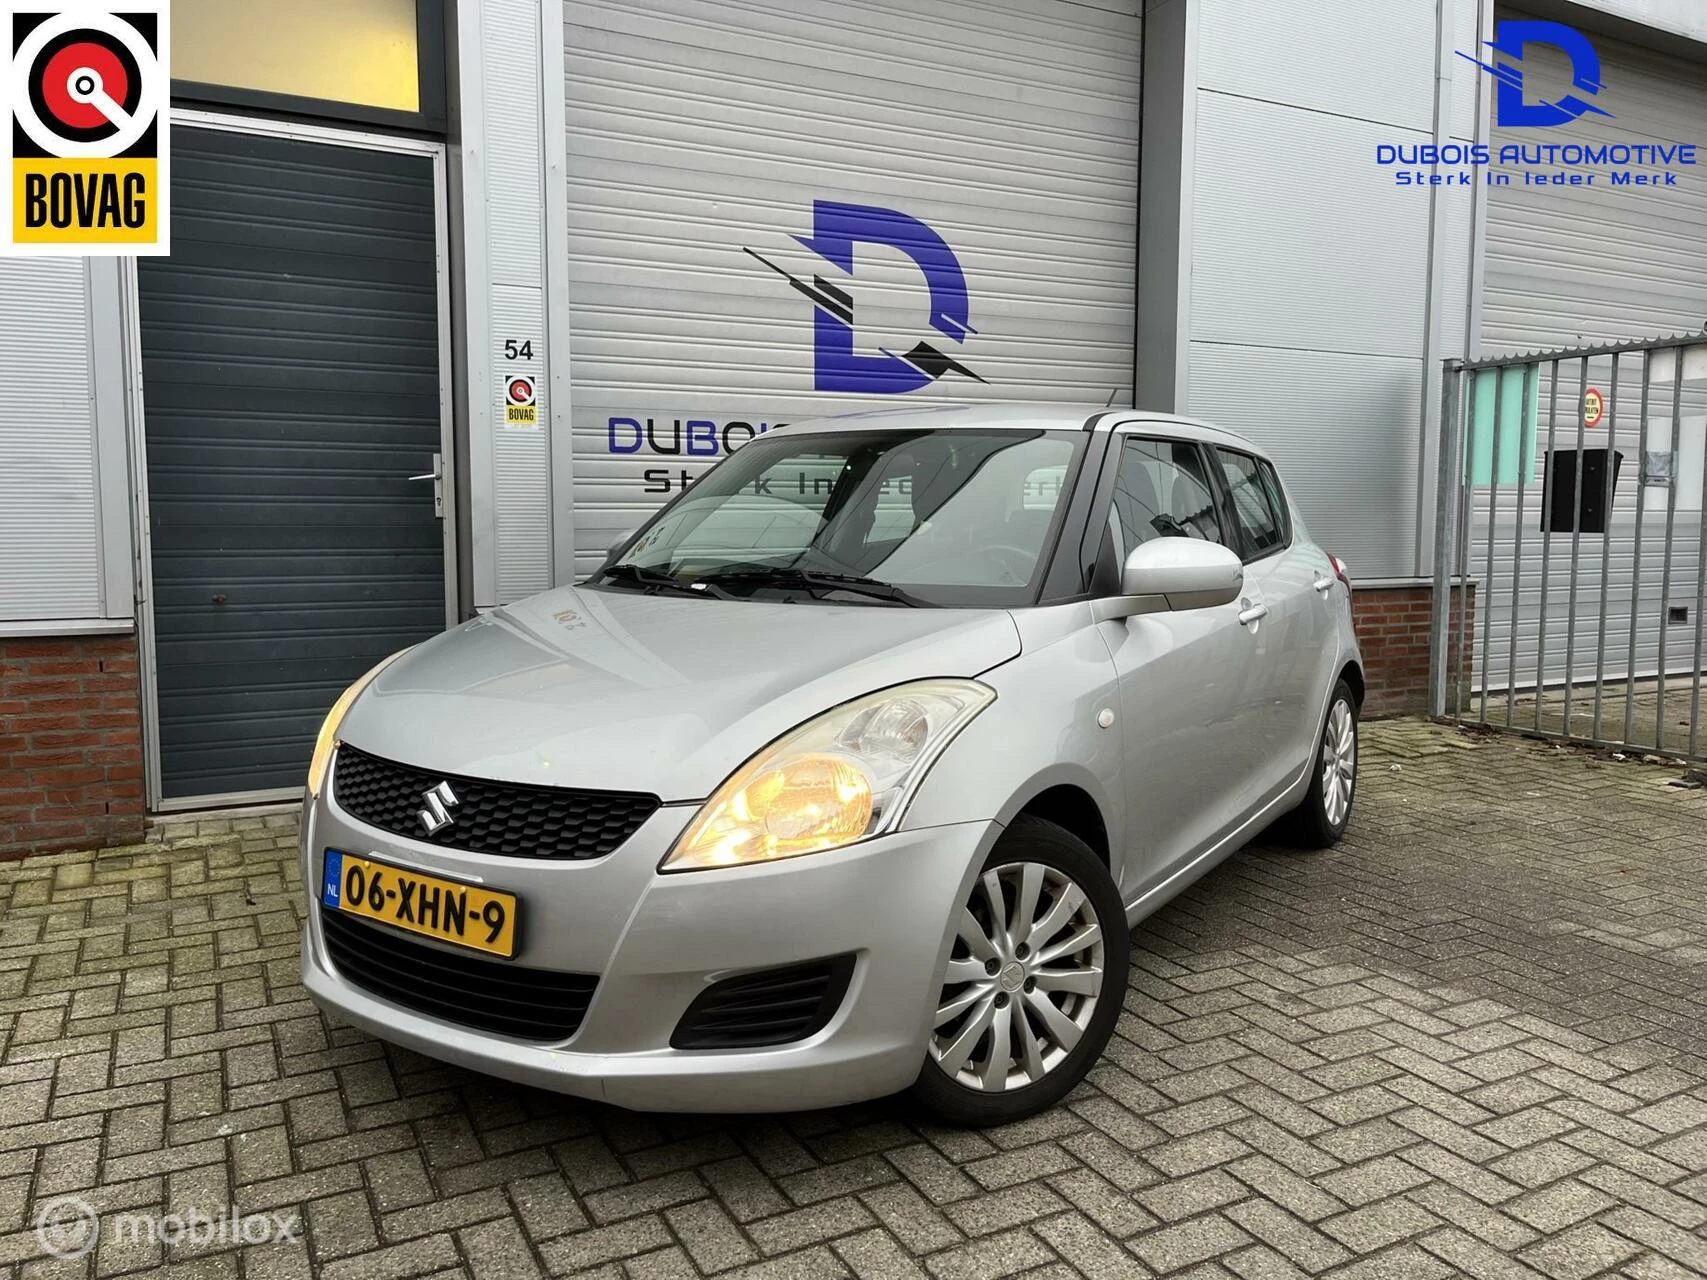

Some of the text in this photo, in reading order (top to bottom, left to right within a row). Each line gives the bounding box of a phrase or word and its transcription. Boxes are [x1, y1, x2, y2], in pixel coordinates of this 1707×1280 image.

[504, 339, 534, 360] 54
[508, 408, 534, 421] BOVAG
[608, 417, 791, 456] DUBO
[327, 883, 339, 898] NL
[345, 864, 506, 944] 06-XHN-9
